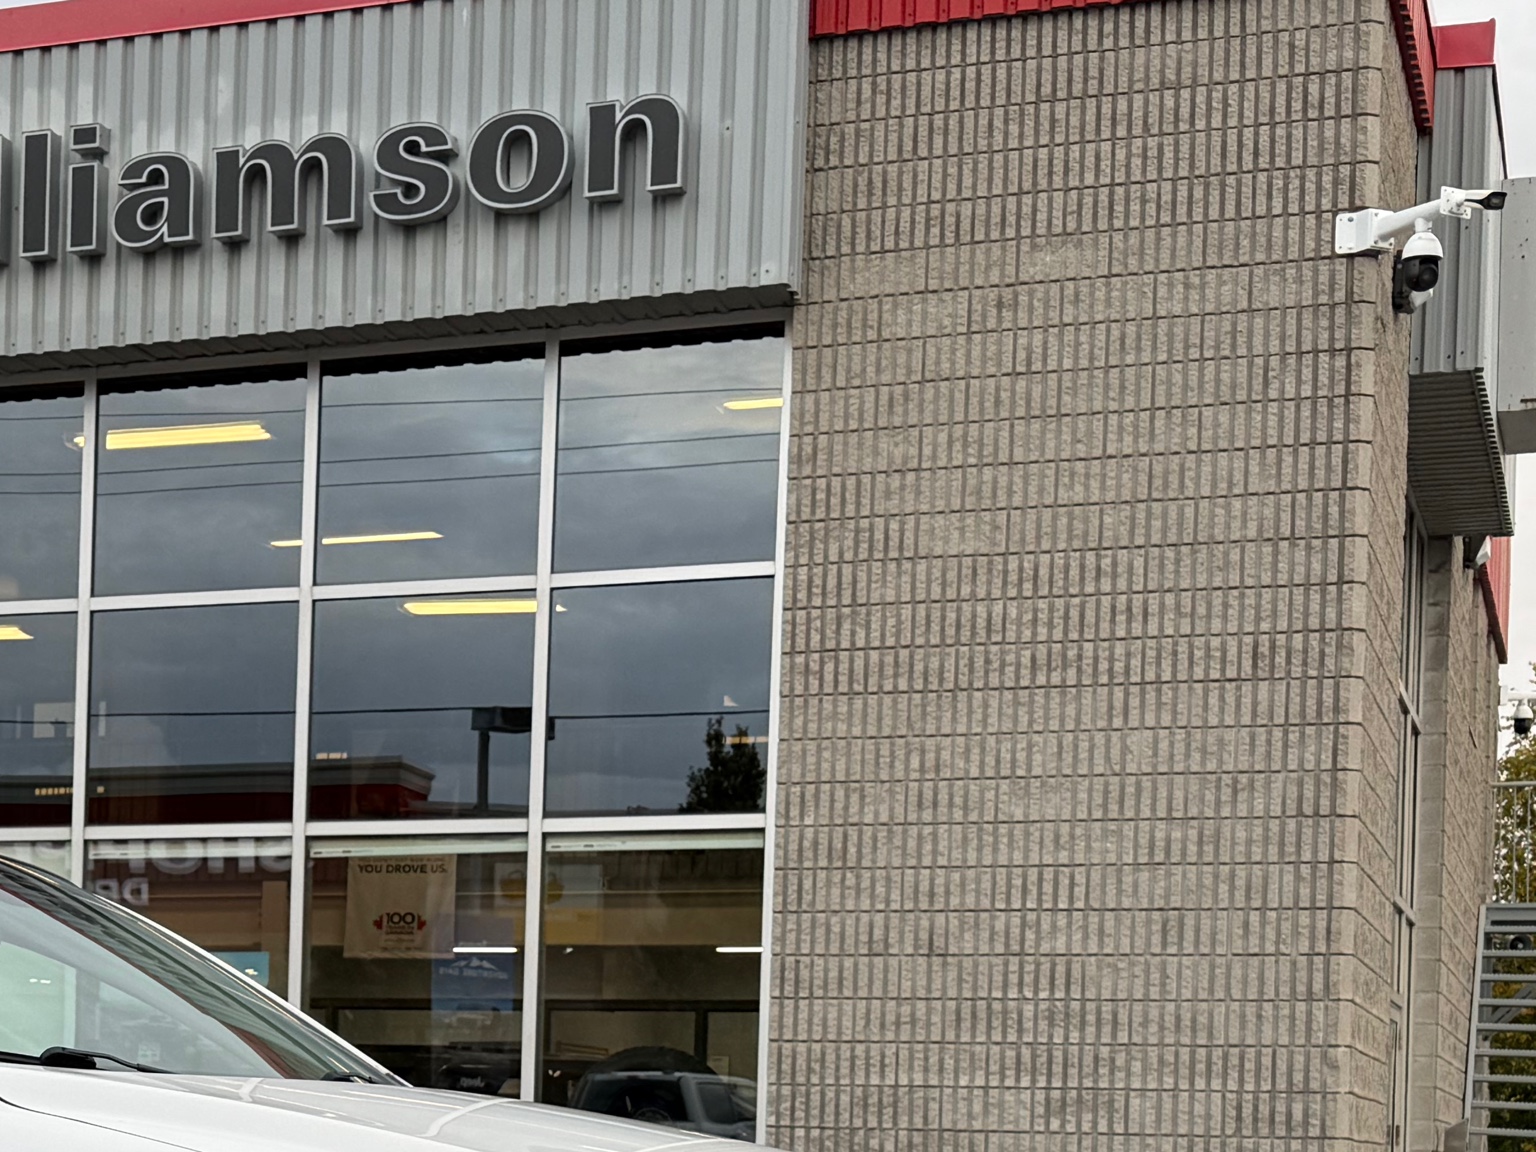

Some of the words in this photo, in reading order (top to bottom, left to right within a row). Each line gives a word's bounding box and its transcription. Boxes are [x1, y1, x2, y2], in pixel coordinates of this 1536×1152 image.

[357, 864, 382, 874] YOU
[386, 864, 428, 874] DROVE
[385, 912, 416, 925] 100
